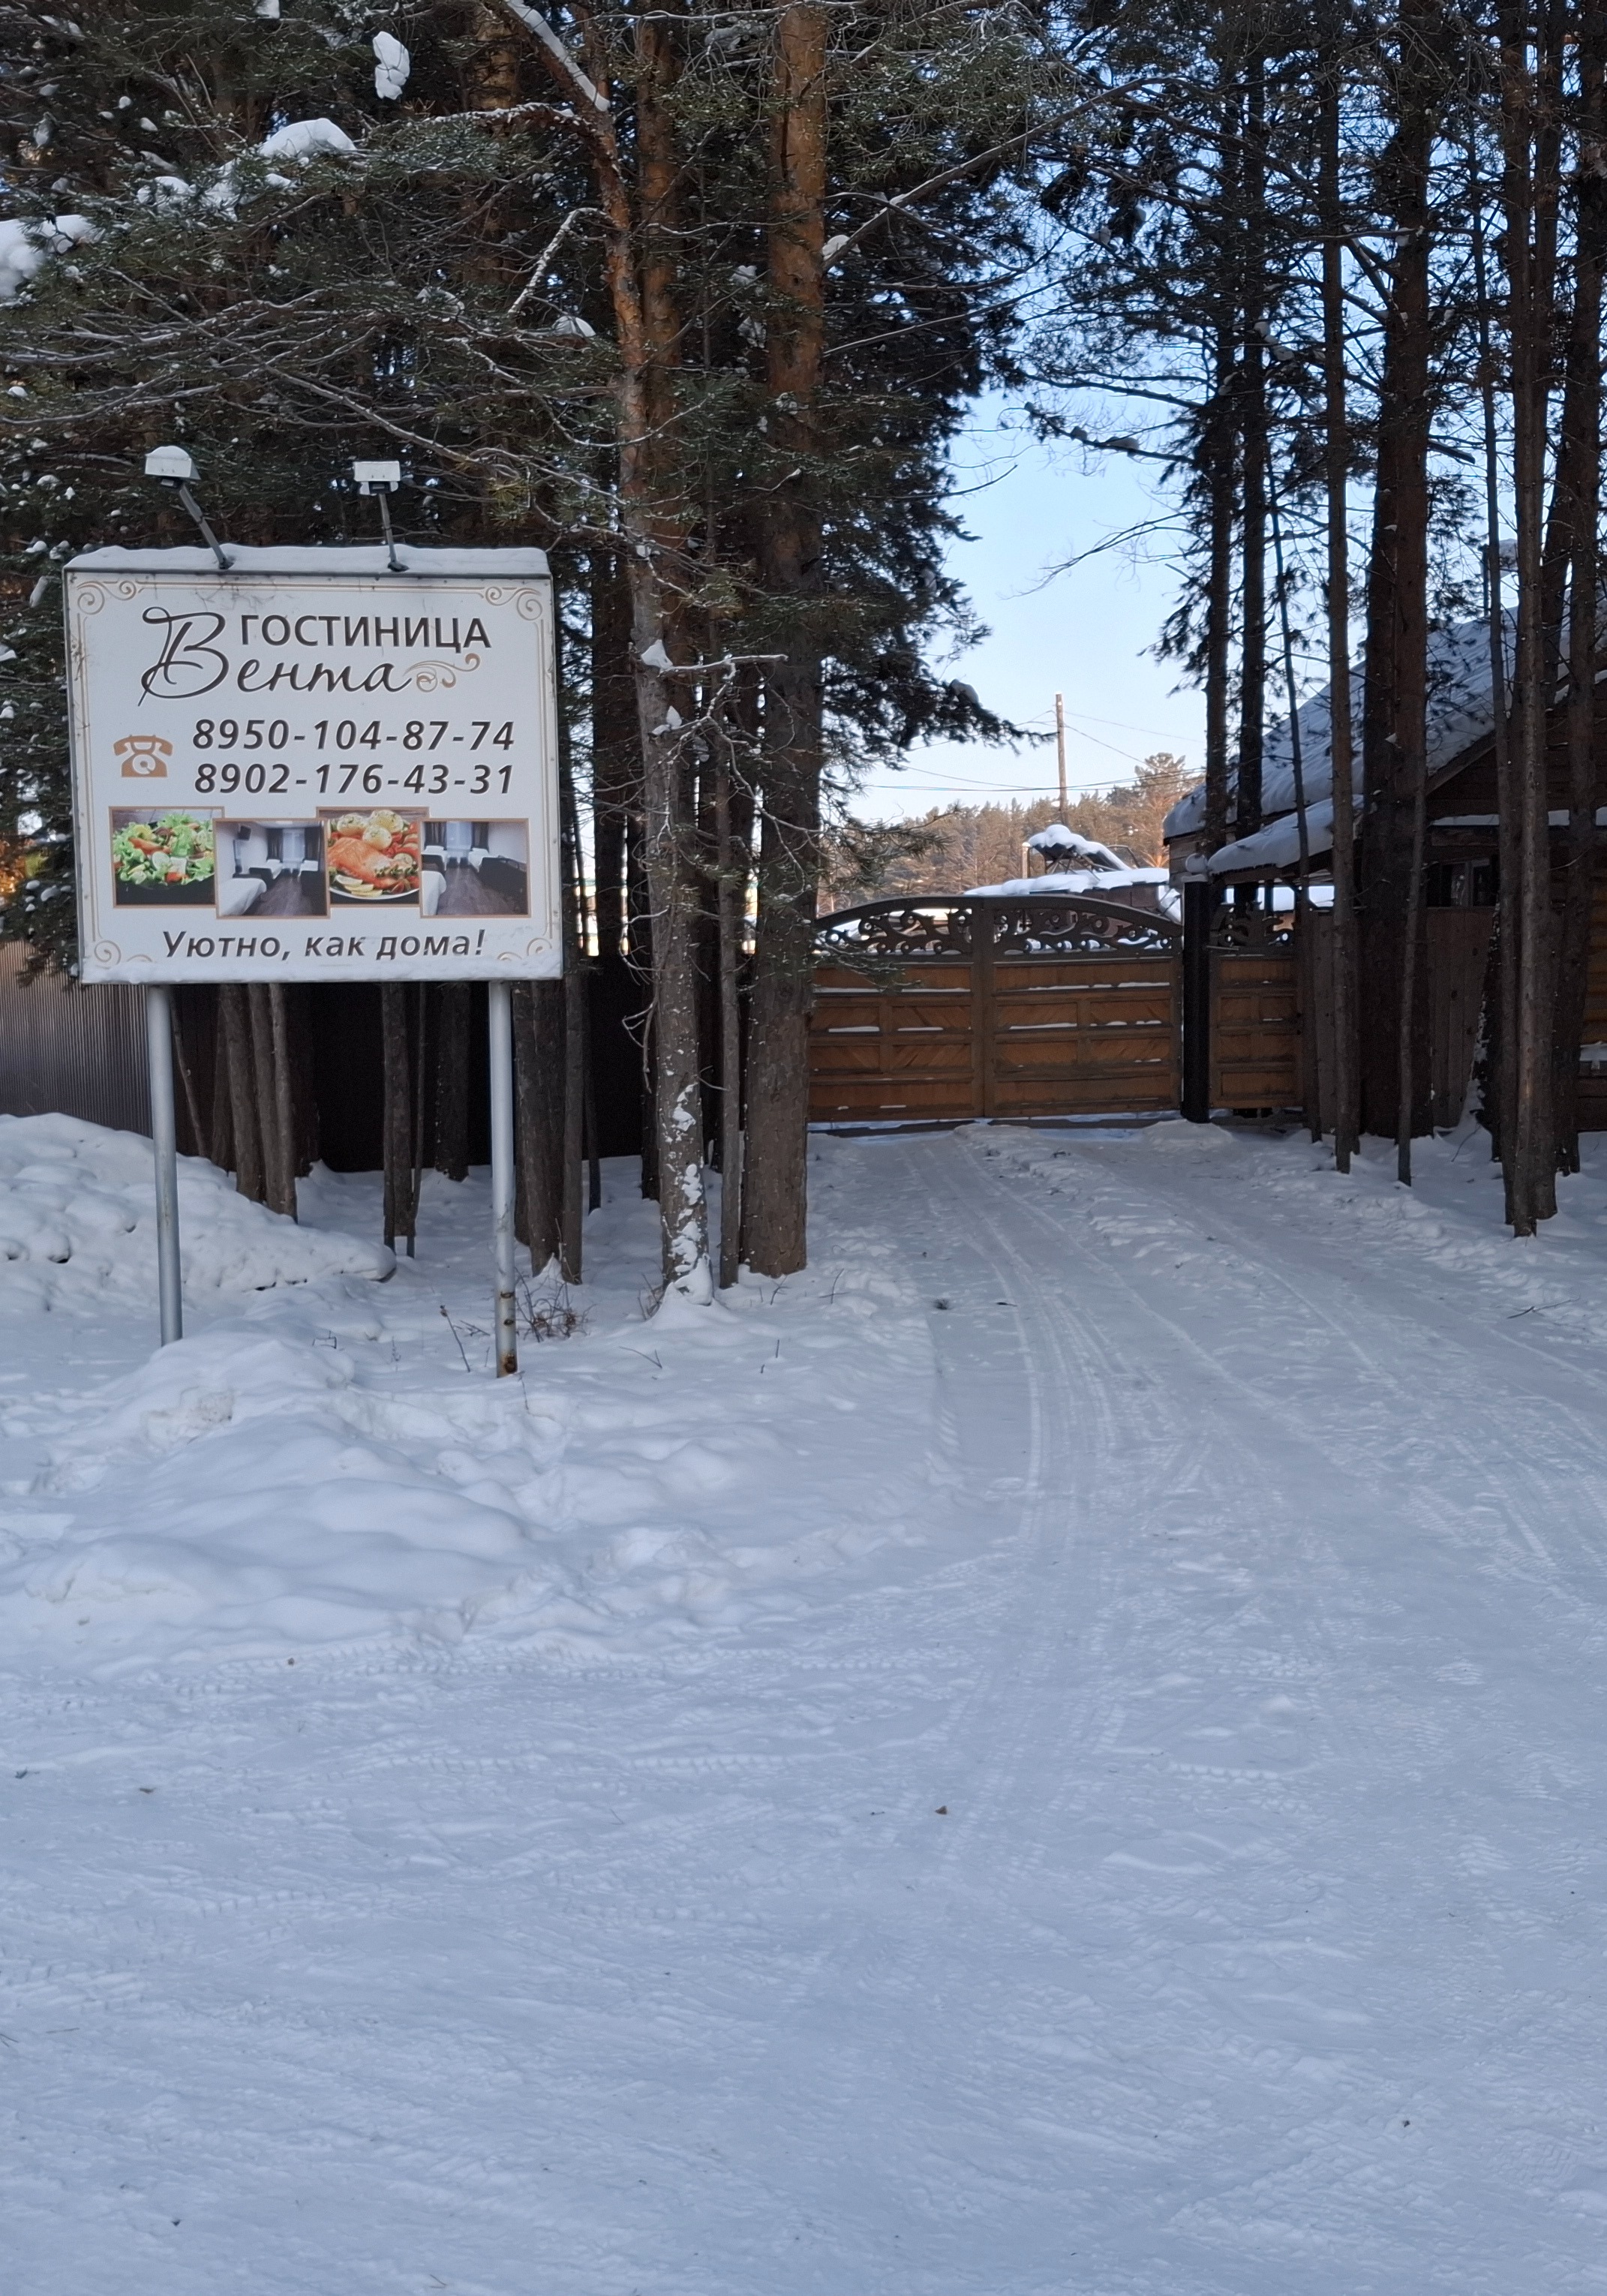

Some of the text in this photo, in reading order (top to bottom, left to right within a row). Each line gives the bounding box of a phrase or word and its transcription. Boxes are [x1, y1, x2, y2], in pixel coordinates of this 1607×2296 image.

[240, 614, 492, 654] ГОСТИНИЦА
[137, 606, 415, 707] Вента
[192, 718, 515, 752] 8950-104-87-74
[194, 762, 514, 795] 8902-176-43-31
[162, 927, 486, 961] Уютно, как дома!
